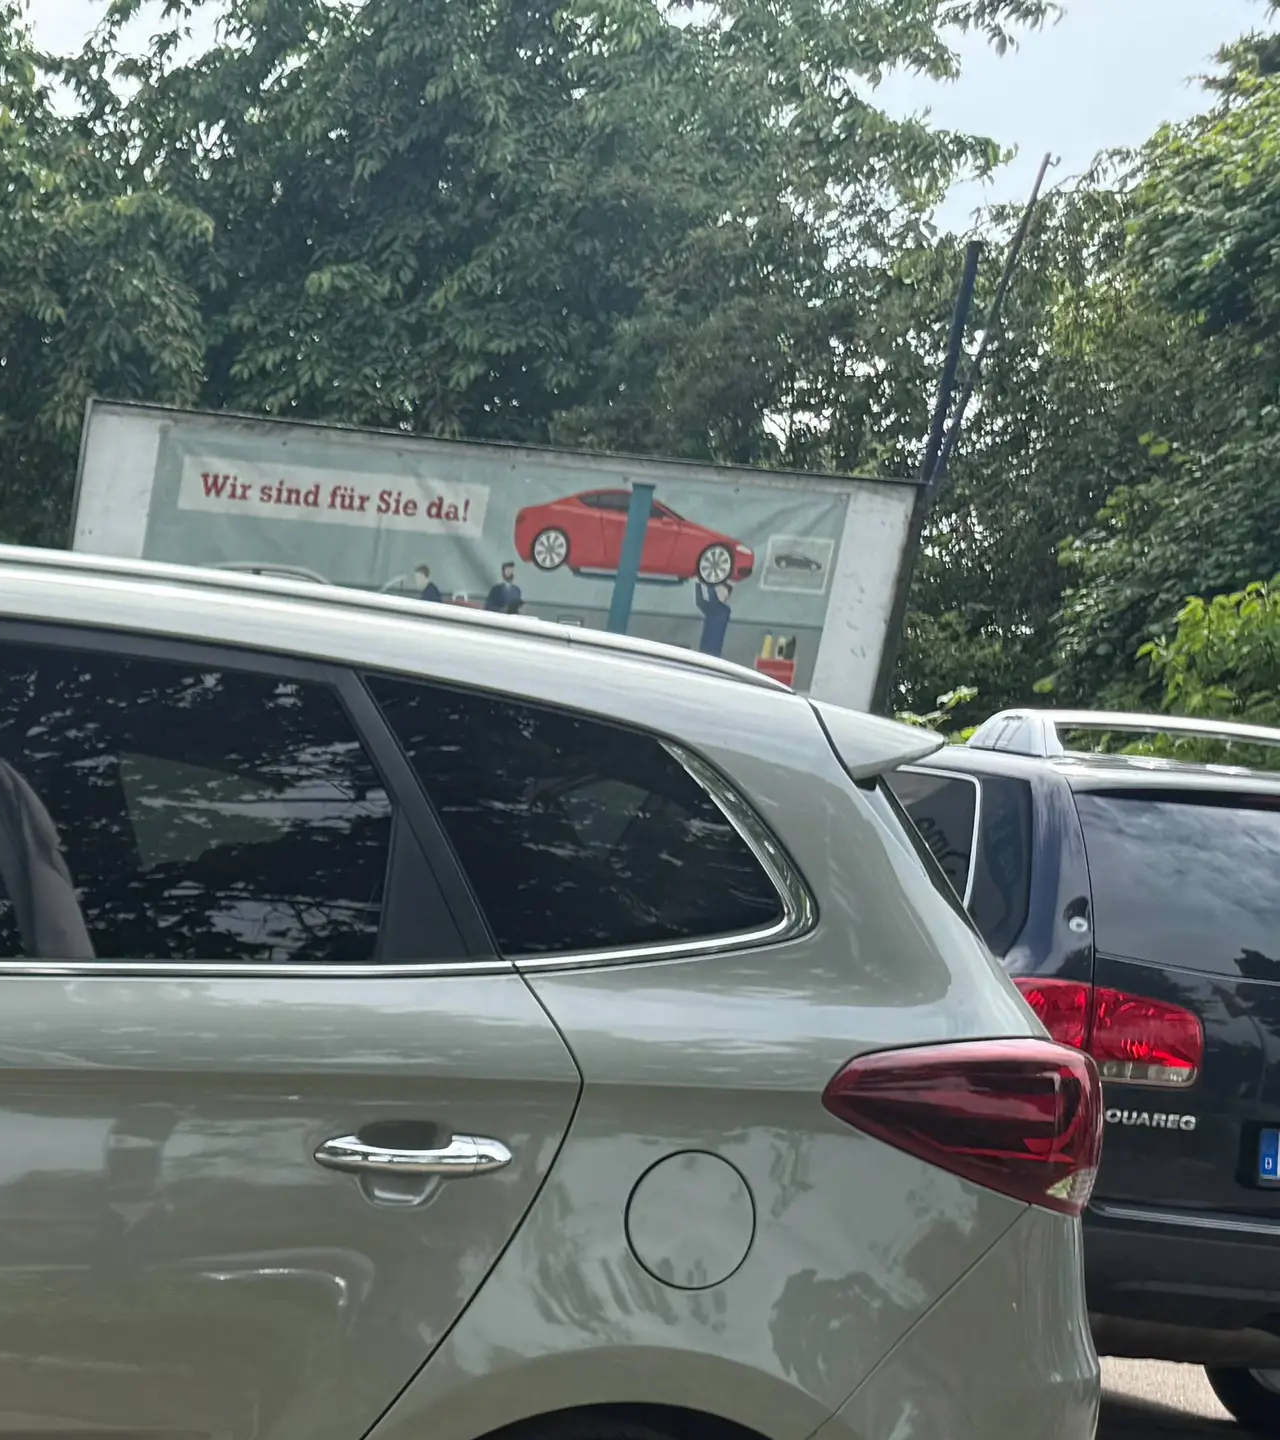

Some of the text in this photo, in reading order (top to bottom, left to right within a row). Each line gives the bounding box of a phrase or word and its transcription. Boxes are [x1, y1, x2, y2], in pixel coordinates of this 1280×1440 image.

[200, 472, 470, 522] Wir sind für Sie da!
